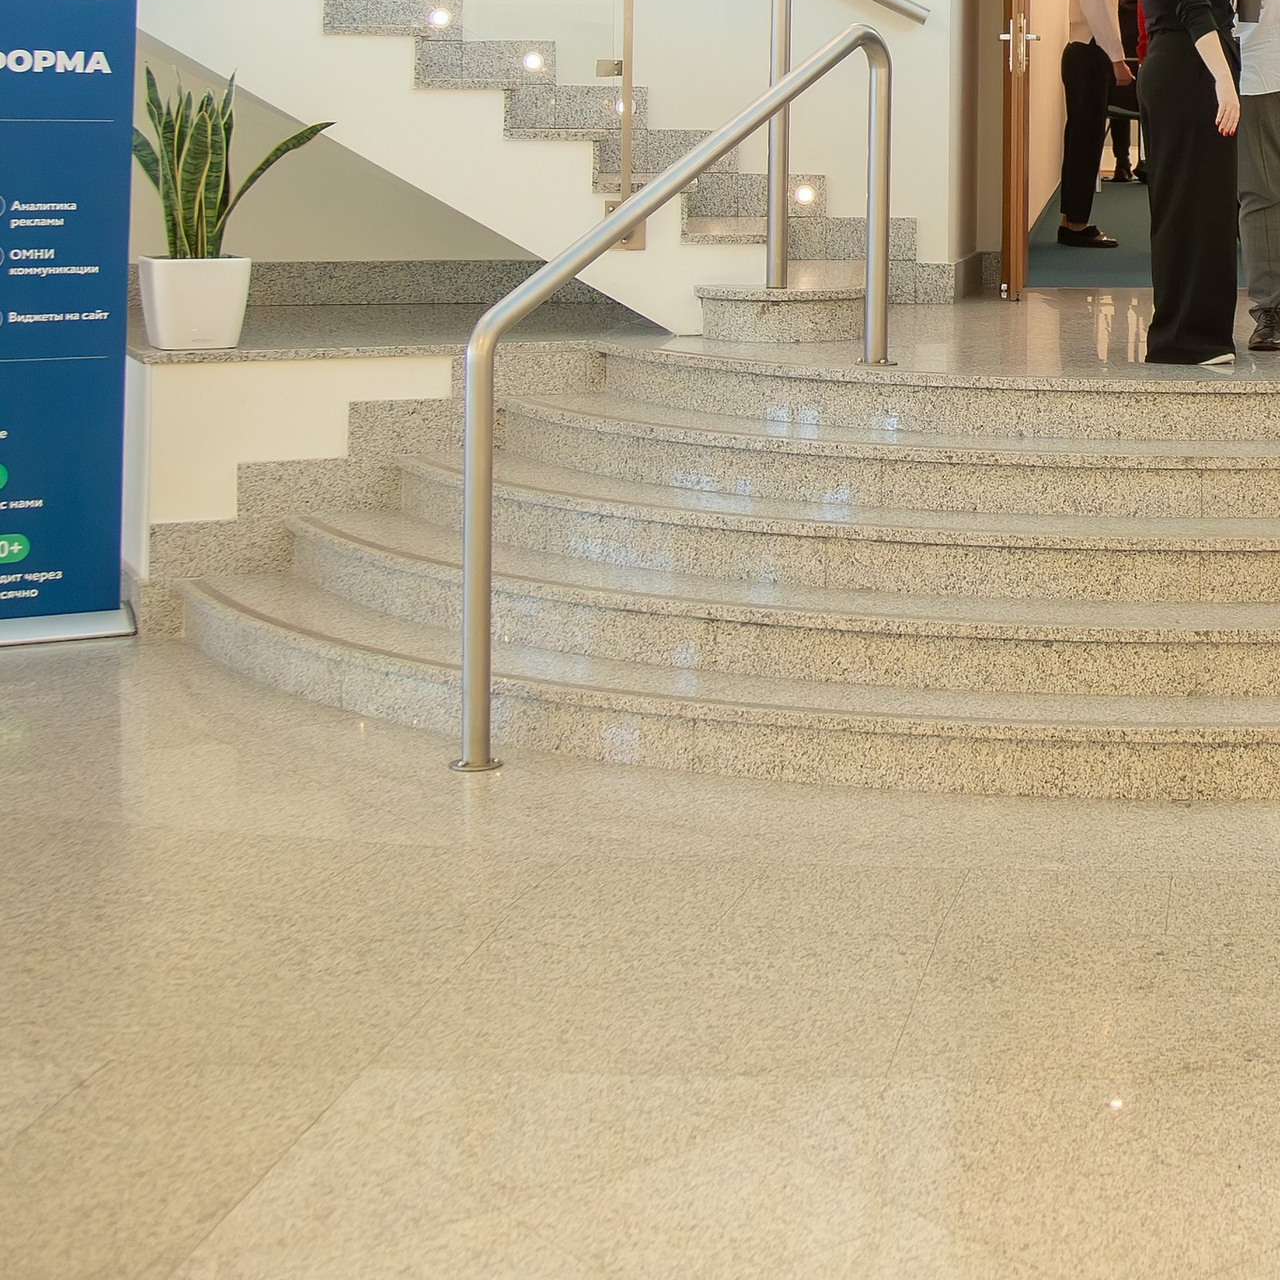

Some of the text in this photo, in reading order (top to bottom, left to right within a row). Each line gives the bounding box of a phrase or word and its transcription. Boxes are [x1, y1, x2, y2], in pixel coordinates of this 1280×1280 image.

[10, 200, 78, 211] Аналитика
[10, 218, 65, 229] рекламы
[9, 248, 55, 260] ОМНИ
[9, 266, 100, 277] коммуникации
[8, 309, 110, 323] Виджеты на сайт
[9, 499, 43, 509] нами
[24, 570, 63, 583] через
